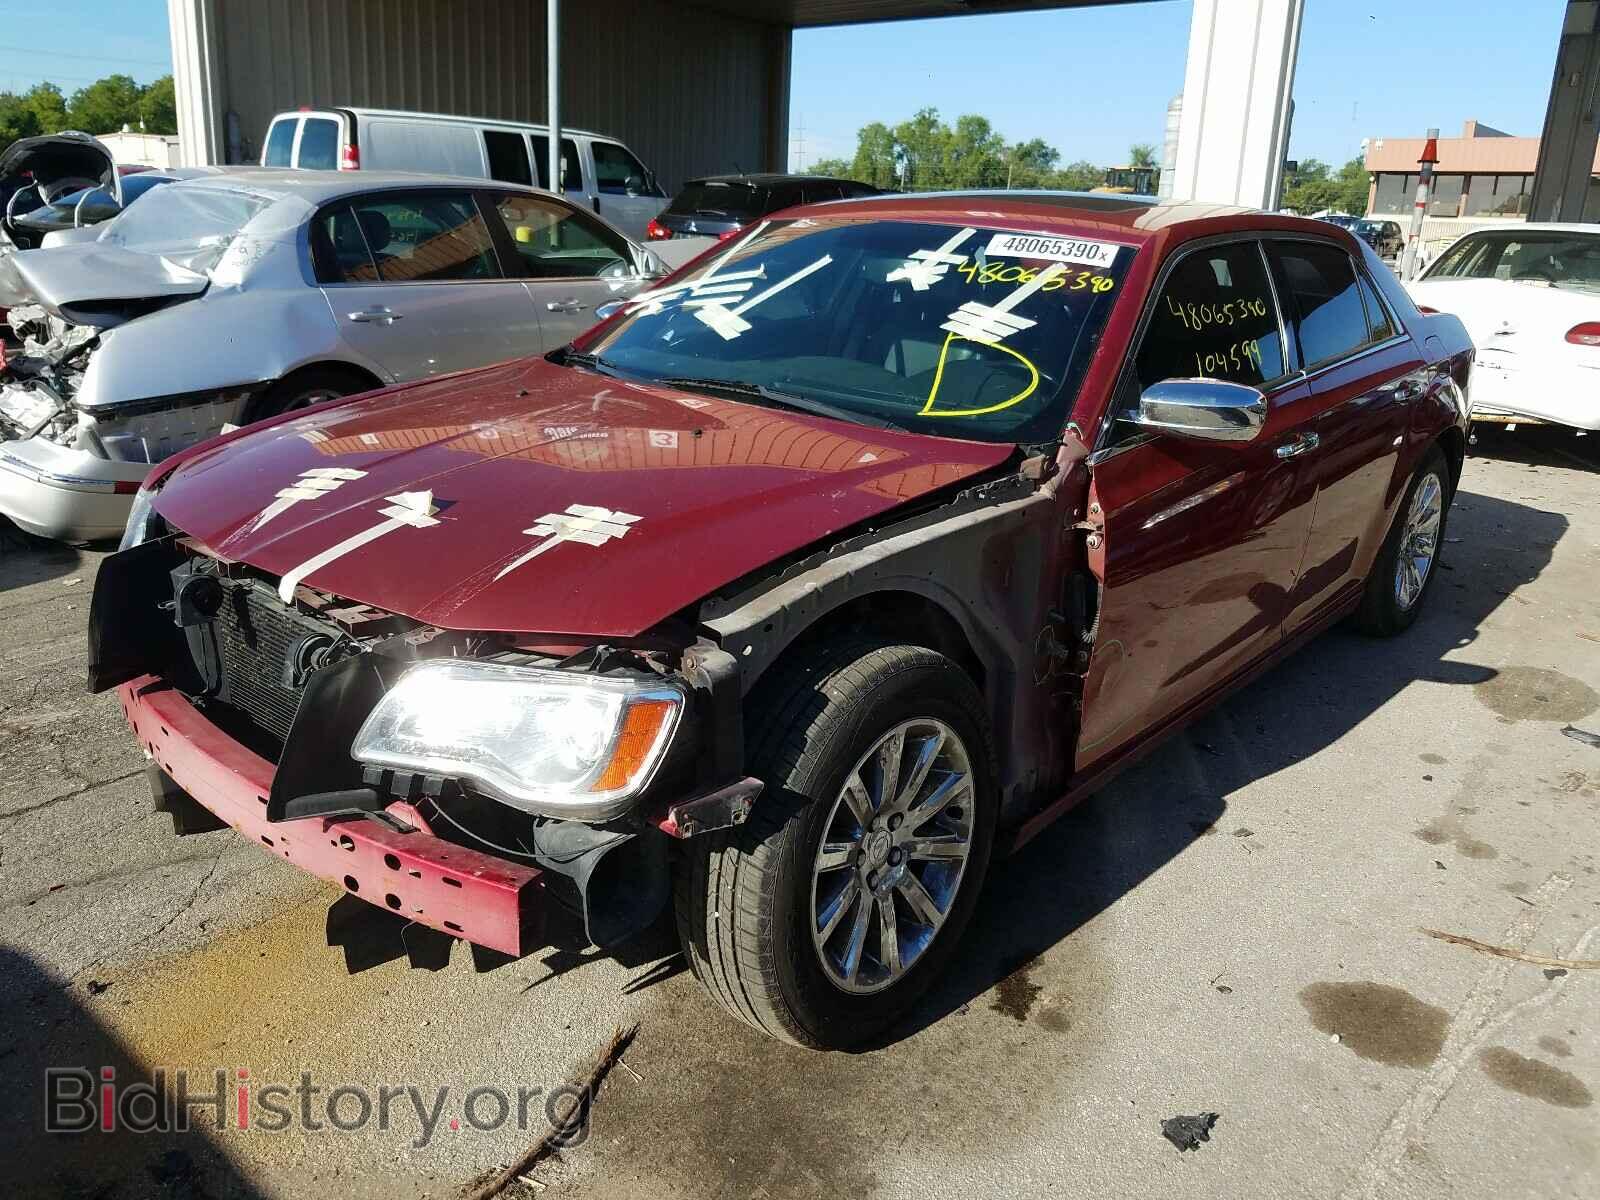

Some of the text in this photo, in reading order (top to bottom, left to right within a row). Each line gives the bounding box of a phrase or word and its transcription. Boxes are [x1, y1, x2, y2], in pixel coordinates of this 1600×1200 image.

[957, 261, 1114, 293] 48065390
[1166, 296, 1266, 331] 48065390
[1195, 339, 1263, 378] 104599
